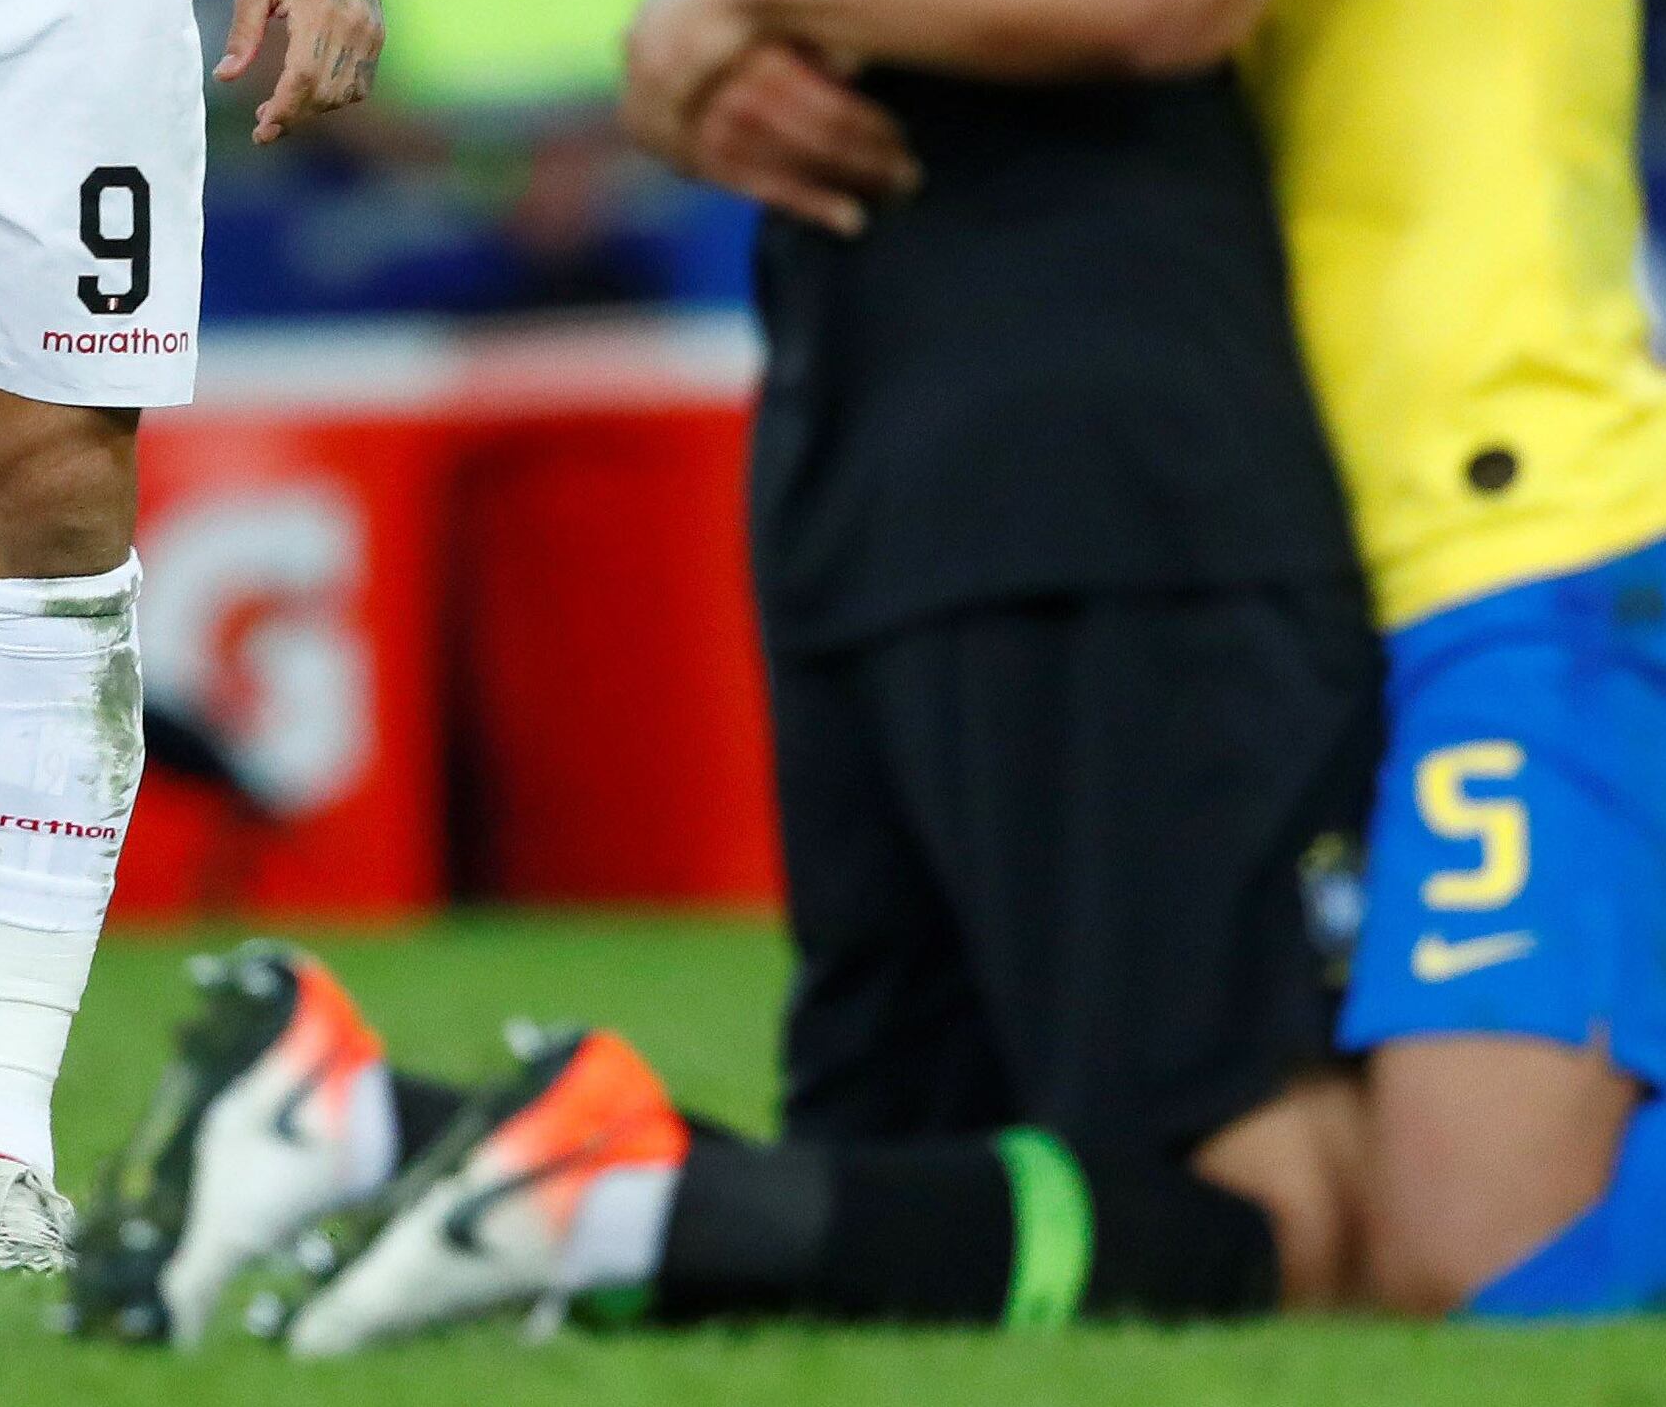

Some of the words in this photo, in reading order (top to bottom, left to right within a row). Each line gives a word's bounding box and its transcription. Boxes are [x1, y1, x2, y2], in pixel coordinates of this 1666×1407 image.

[77, 166, 151, 315] 9
[42, 327, 189, 355] marathon
[129, 479, 378, 814] G
[1413, 738, 1531, 911] 5
